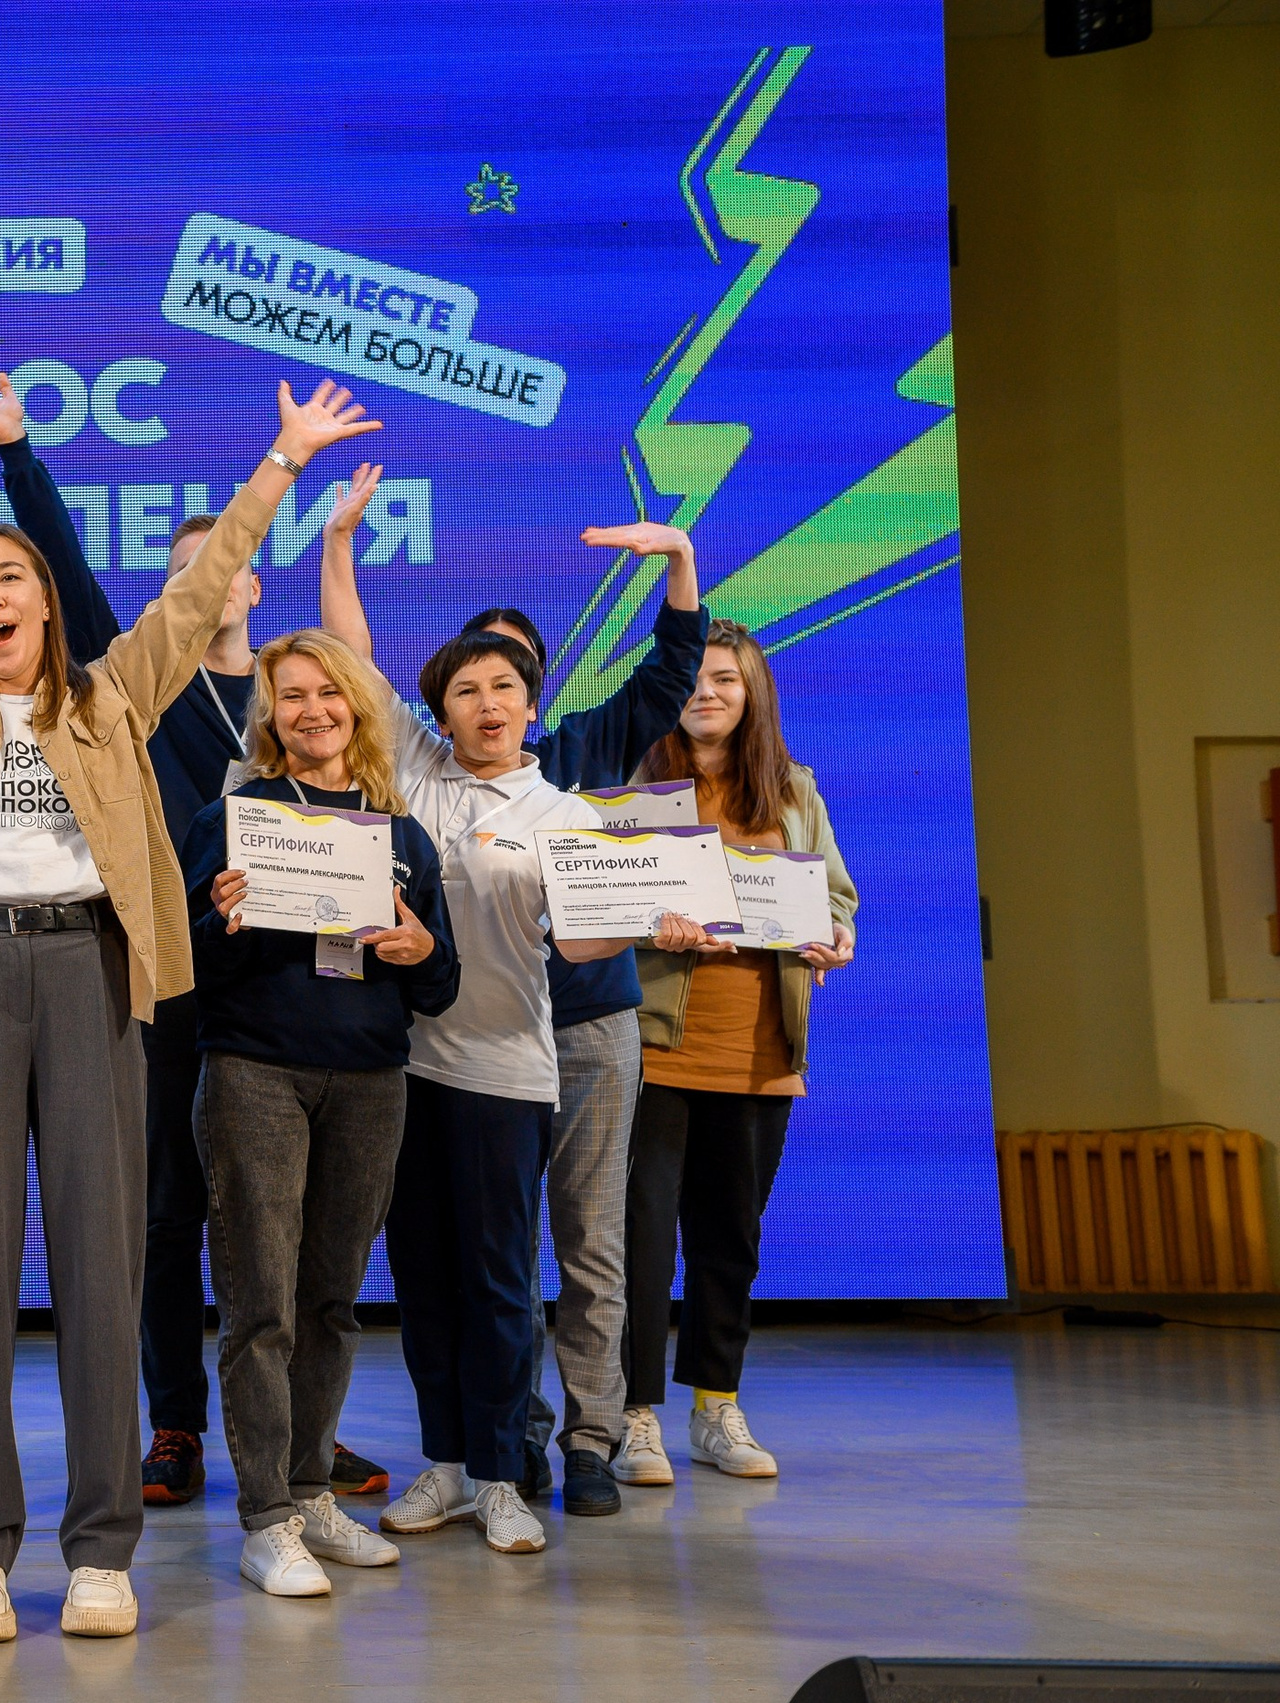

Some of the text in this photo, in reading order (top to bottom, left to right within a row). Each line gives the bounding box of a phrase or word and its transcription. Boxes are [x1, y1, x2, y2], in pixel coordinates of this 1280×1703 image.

[197, 235, 457, 334] МЫ ВМЕСТЕ
[184, 280, 544, 406] МОЖЕМ БОЛЬШЕ
[1, 797, 74, 813] ПОКО
[238, 814, 282, 825] ПОКОЛЕНИЯ
[240, 833, 335, 856] СЕРТИФИКАТ
[248, 862, 365, 882] ШИХАЛЕВА МАРИЯ АЛЕКСАНДРОВНА
[554, 857, 659, 872] СЕРТИФИКАТ
[567, 879, 688, 890] ИВАНЦОВА ГАЛИНА НИКОЛАЕВНА
[742, 896, 778, 904] АЛЕКСЕЕВНА
